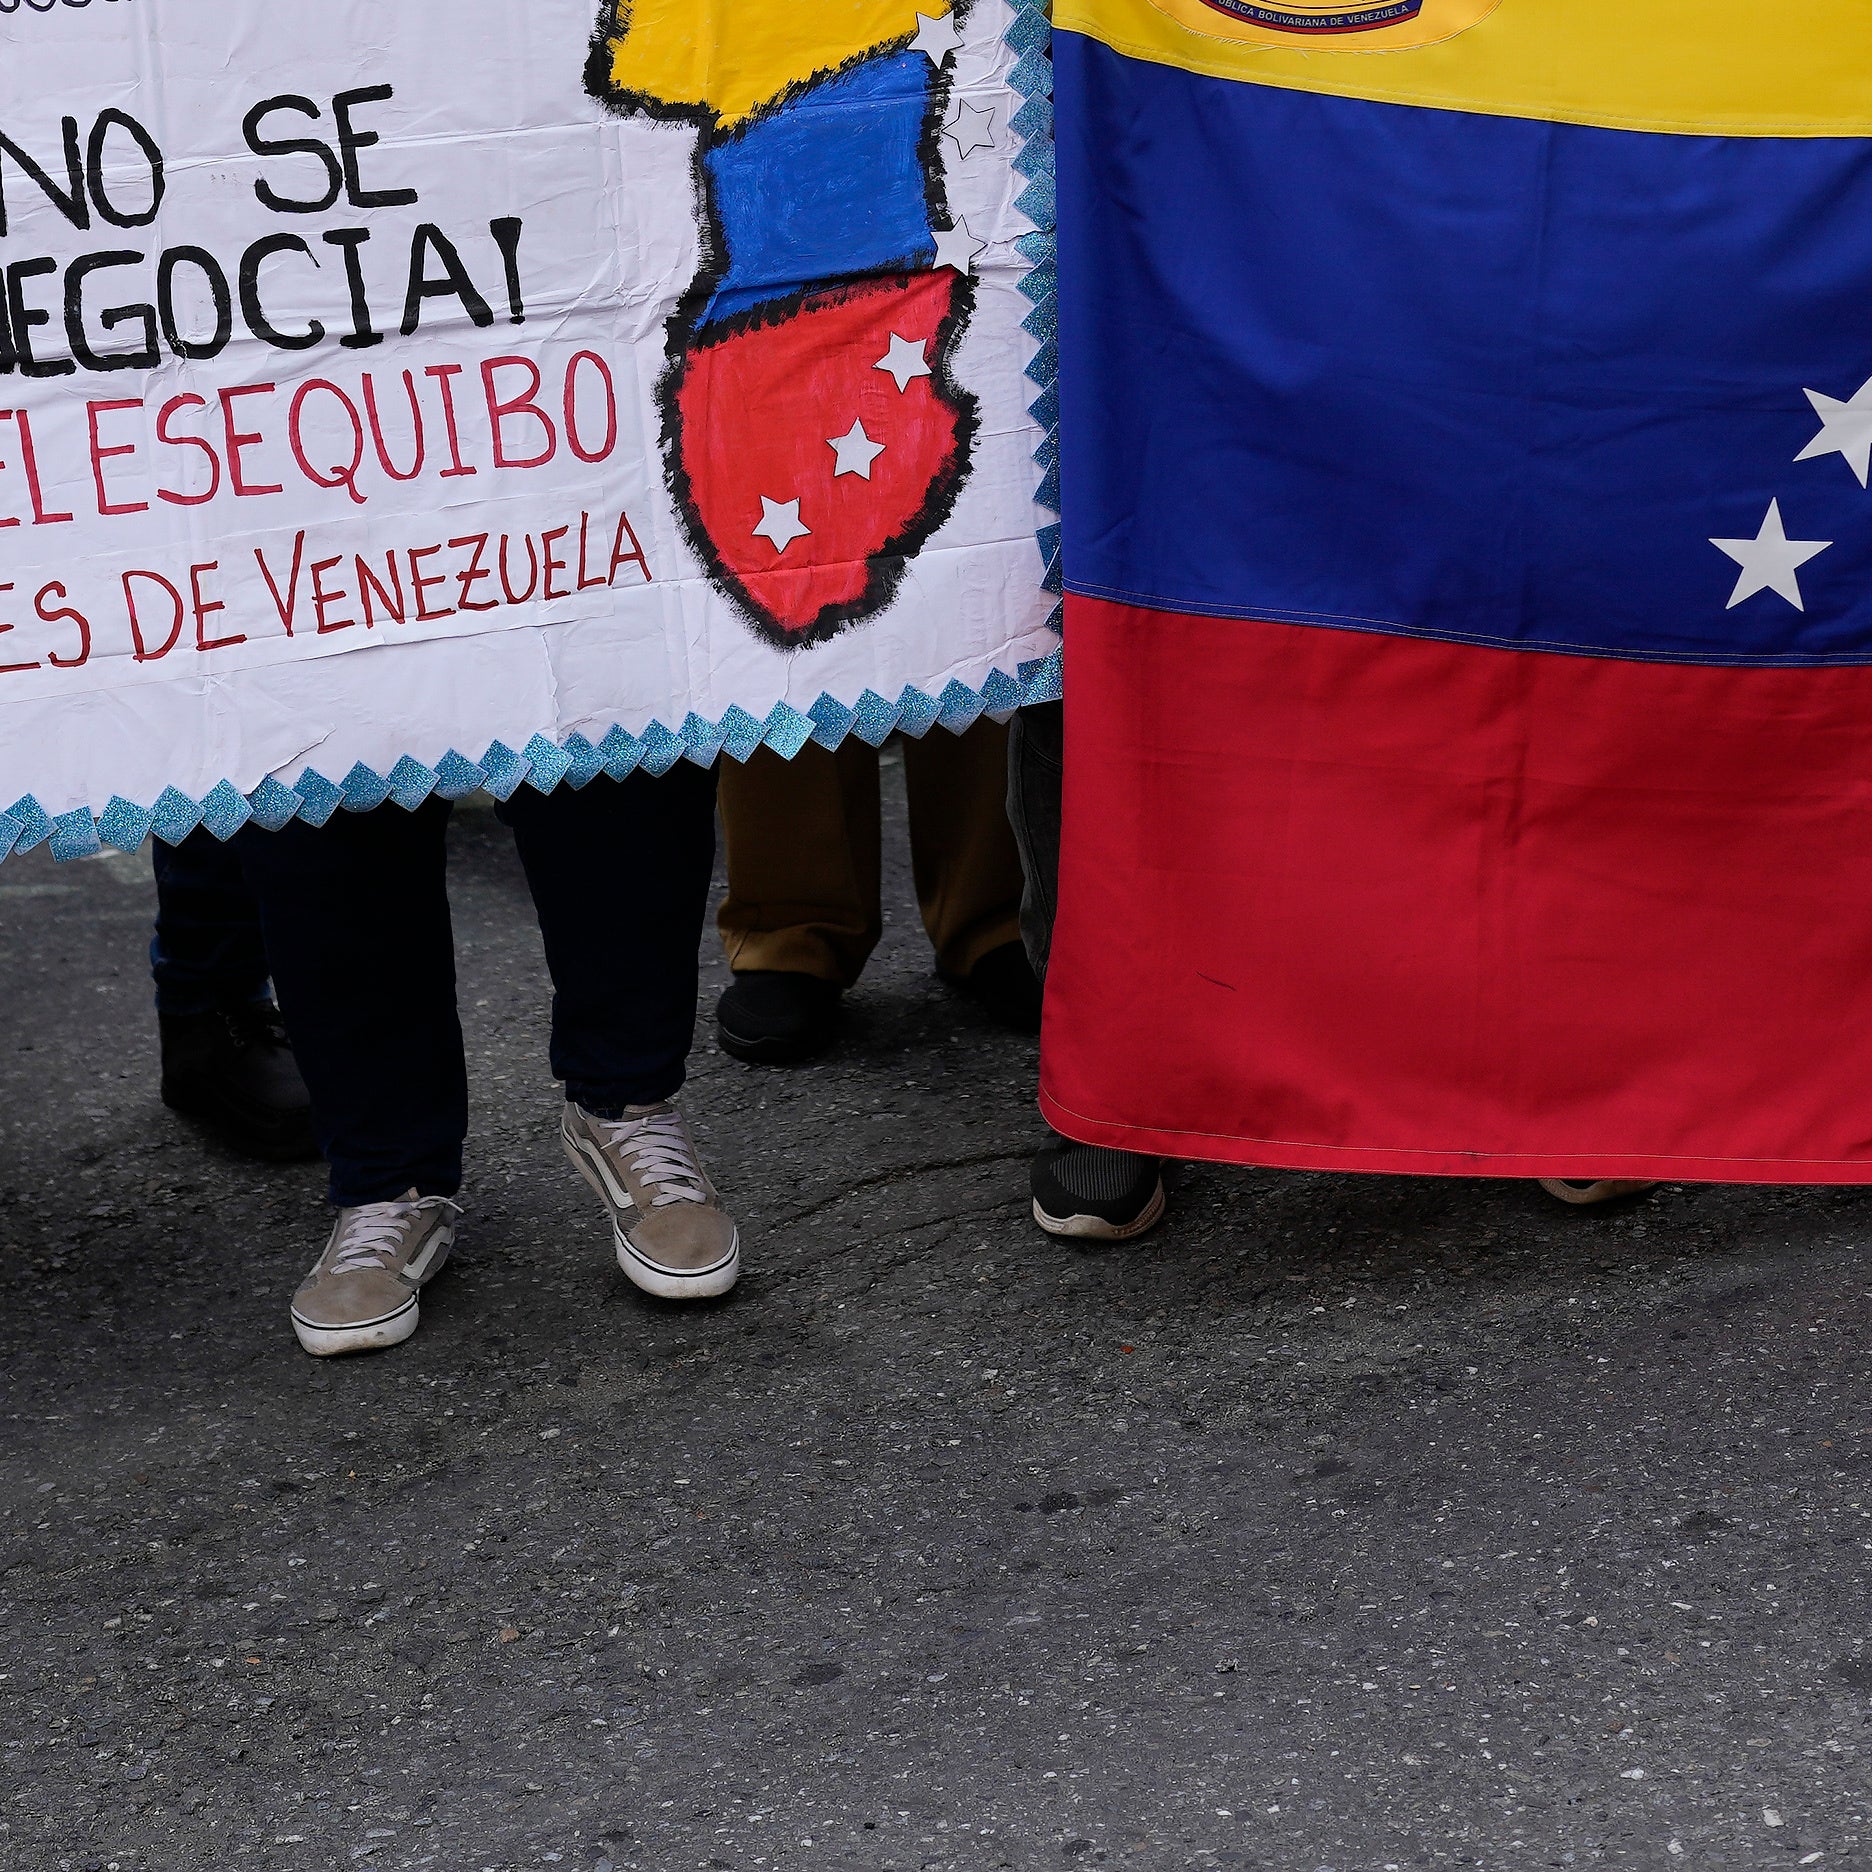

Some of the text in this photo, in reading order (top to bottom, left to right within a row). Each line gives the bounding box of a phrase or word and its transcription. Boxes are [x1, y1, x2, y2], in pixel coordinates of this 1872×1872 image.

[1257, 9, 1327, 27] BOLIVARIANA
[1329, 16, 1344, 26] DE
[1346, 4, 1409, 24] VENEZUELA
[243, 84, 418, 213] SE
[123, 560, 247, 663] DE
[255, 511, 654, 639] VENEZUELA
